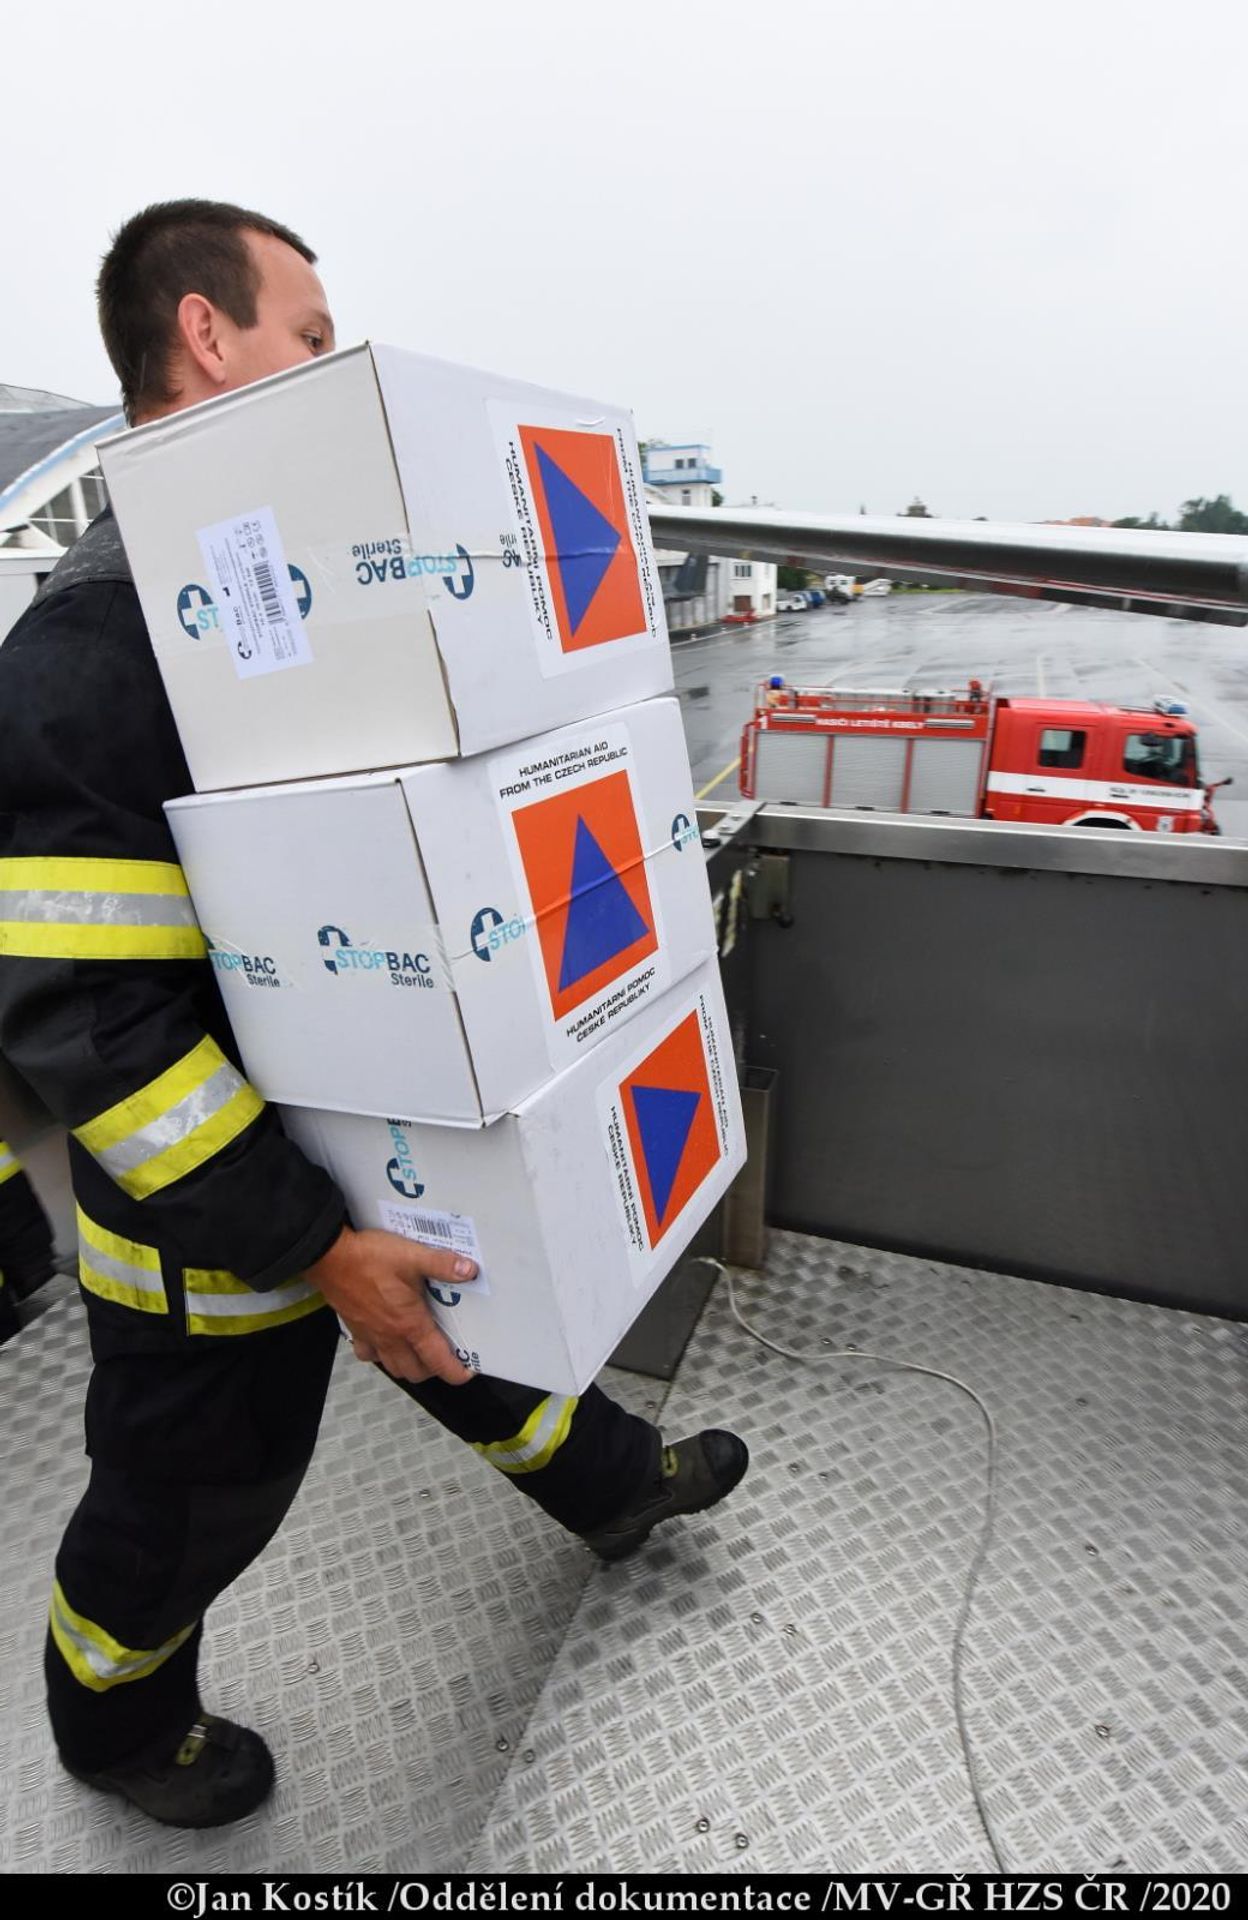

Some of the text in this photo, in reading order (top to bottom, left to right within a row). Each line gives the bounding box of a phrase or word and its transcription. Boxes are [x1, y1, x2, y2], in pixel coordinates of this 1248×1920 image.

[352, 538, 401, 560] Sterile
[355, 551, 458, 585] STOPBAC
[518, 741, 609, 778] HUMANITARIAN AID
[499, 747, 628, 799] FROM THE CZECH REPUBLIC
[209, 952, 276, 975] TOPBAC
[335, 949, 431, 974] STOPBAC
[246, 974, 281, 988] Sterile
[390, 972, 435, 989] Sterile
[627, 967, 656, 992] POMOC
[607, 983, 651, 1020] REPUBLIKY
